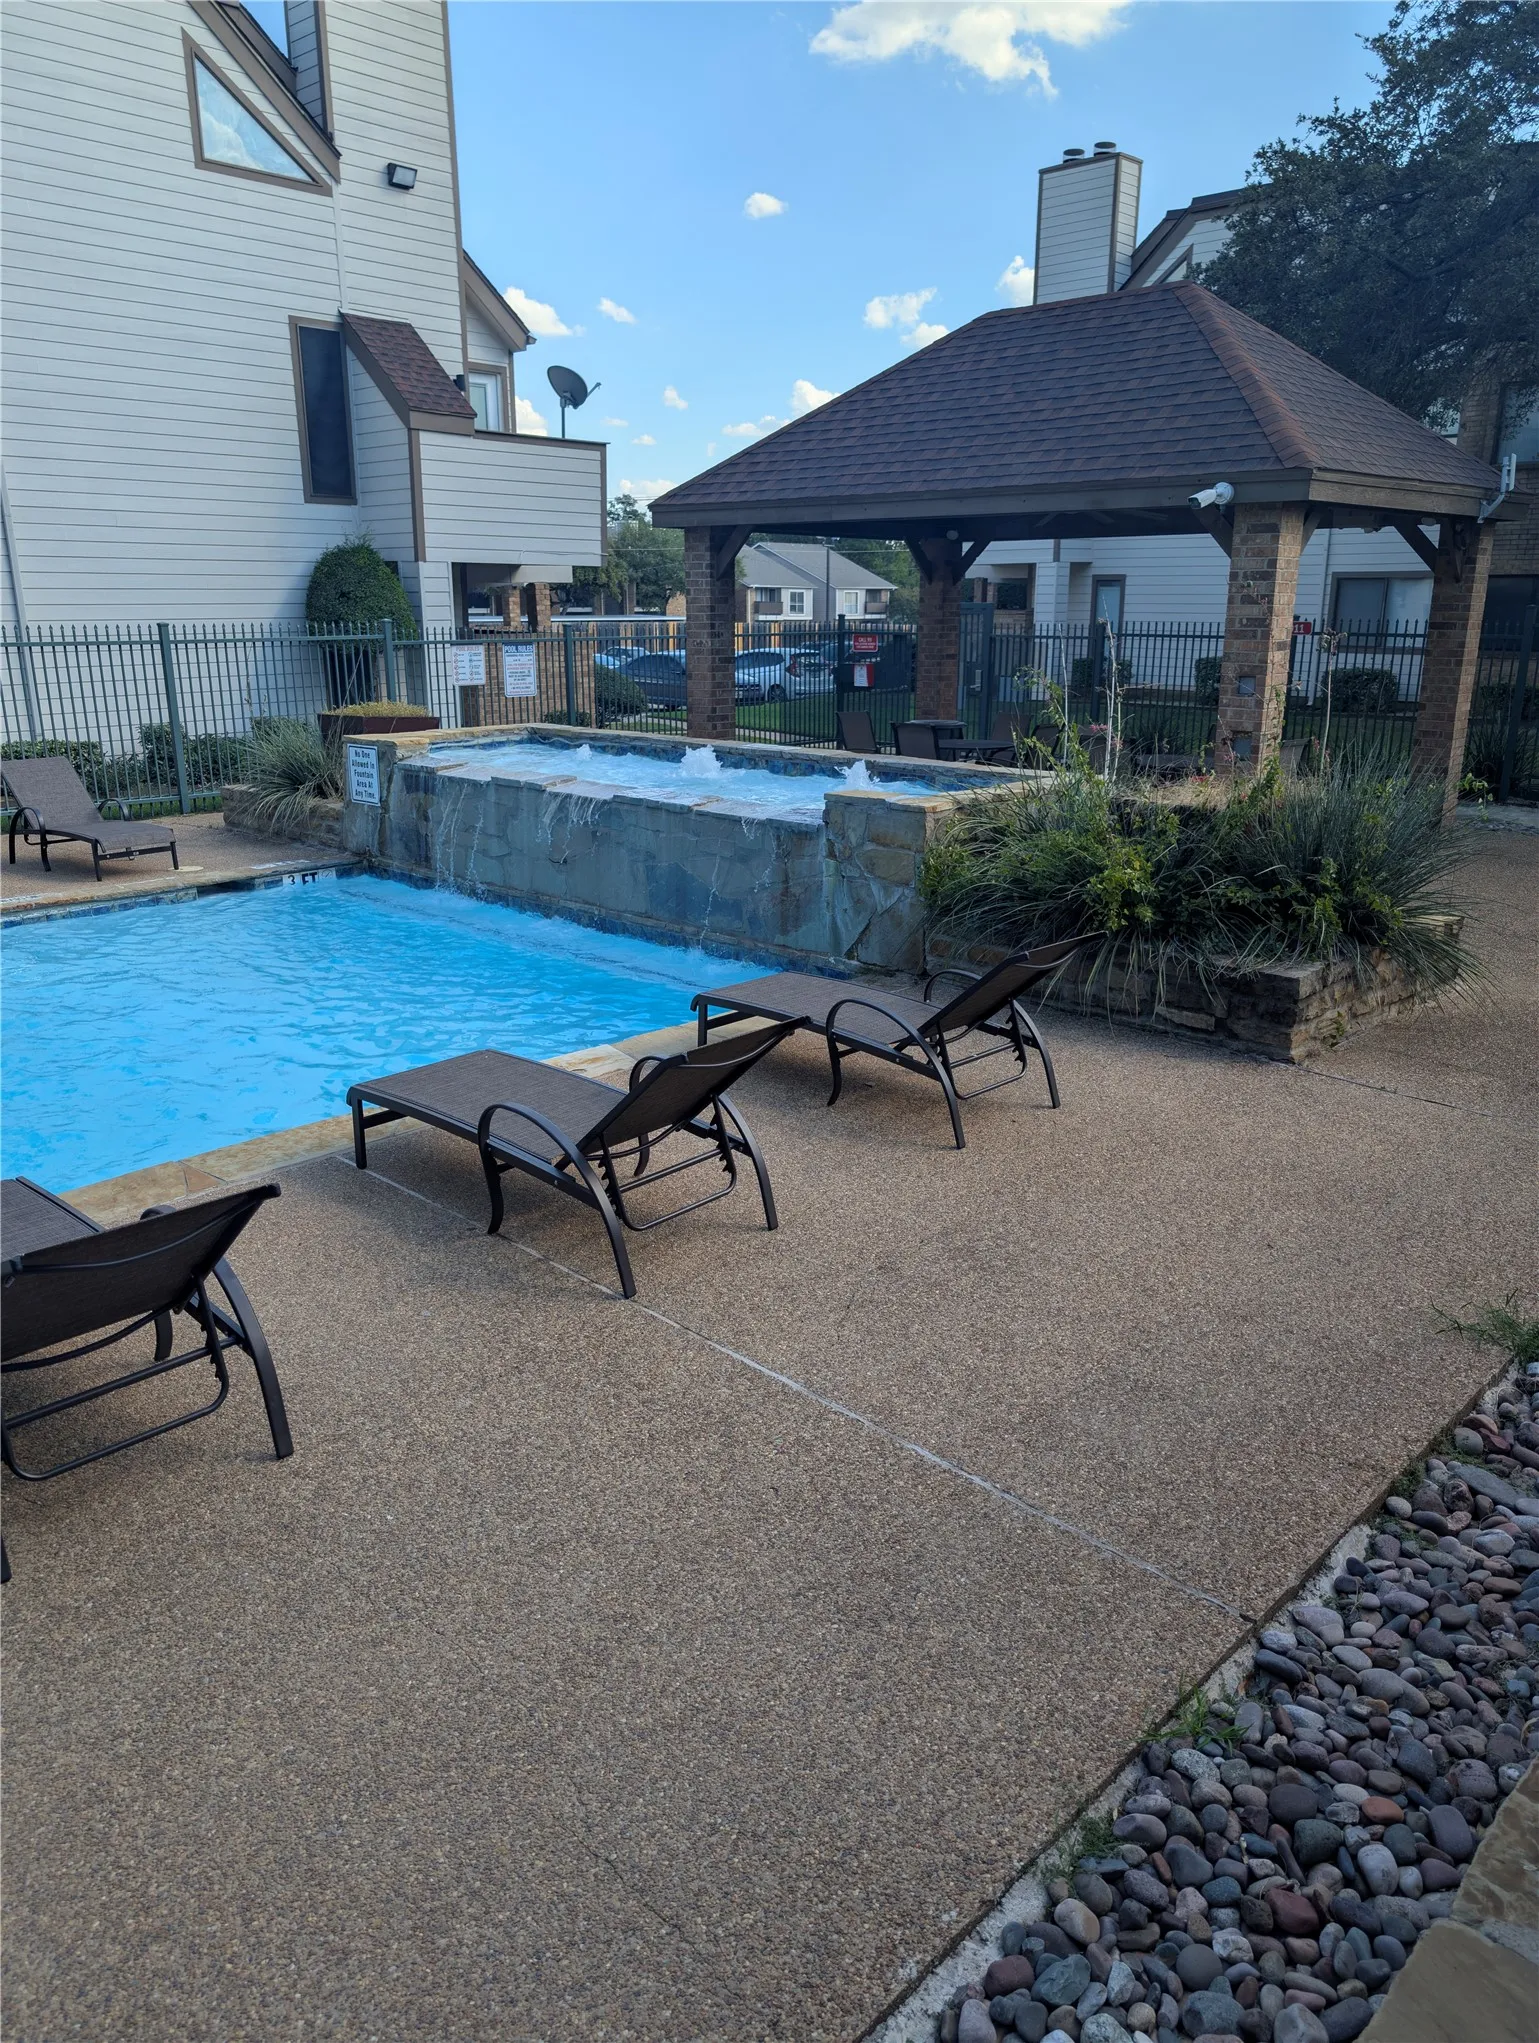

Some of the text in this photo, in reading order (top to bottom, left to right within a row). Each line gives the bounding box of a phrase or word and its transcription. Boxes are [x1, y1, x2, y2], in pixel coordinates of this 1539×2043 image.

[504, 645, 533, 653] POOL RULES
[354, 750, 371, 759] No One
[352, 759, 369, 769] Allowed
[354, 769, 375, 779] Fountain
[357, 779, 374, 789] Area At
[355, 789, 364, 799] Any
[287, 871, 317, 886] 3 FT
